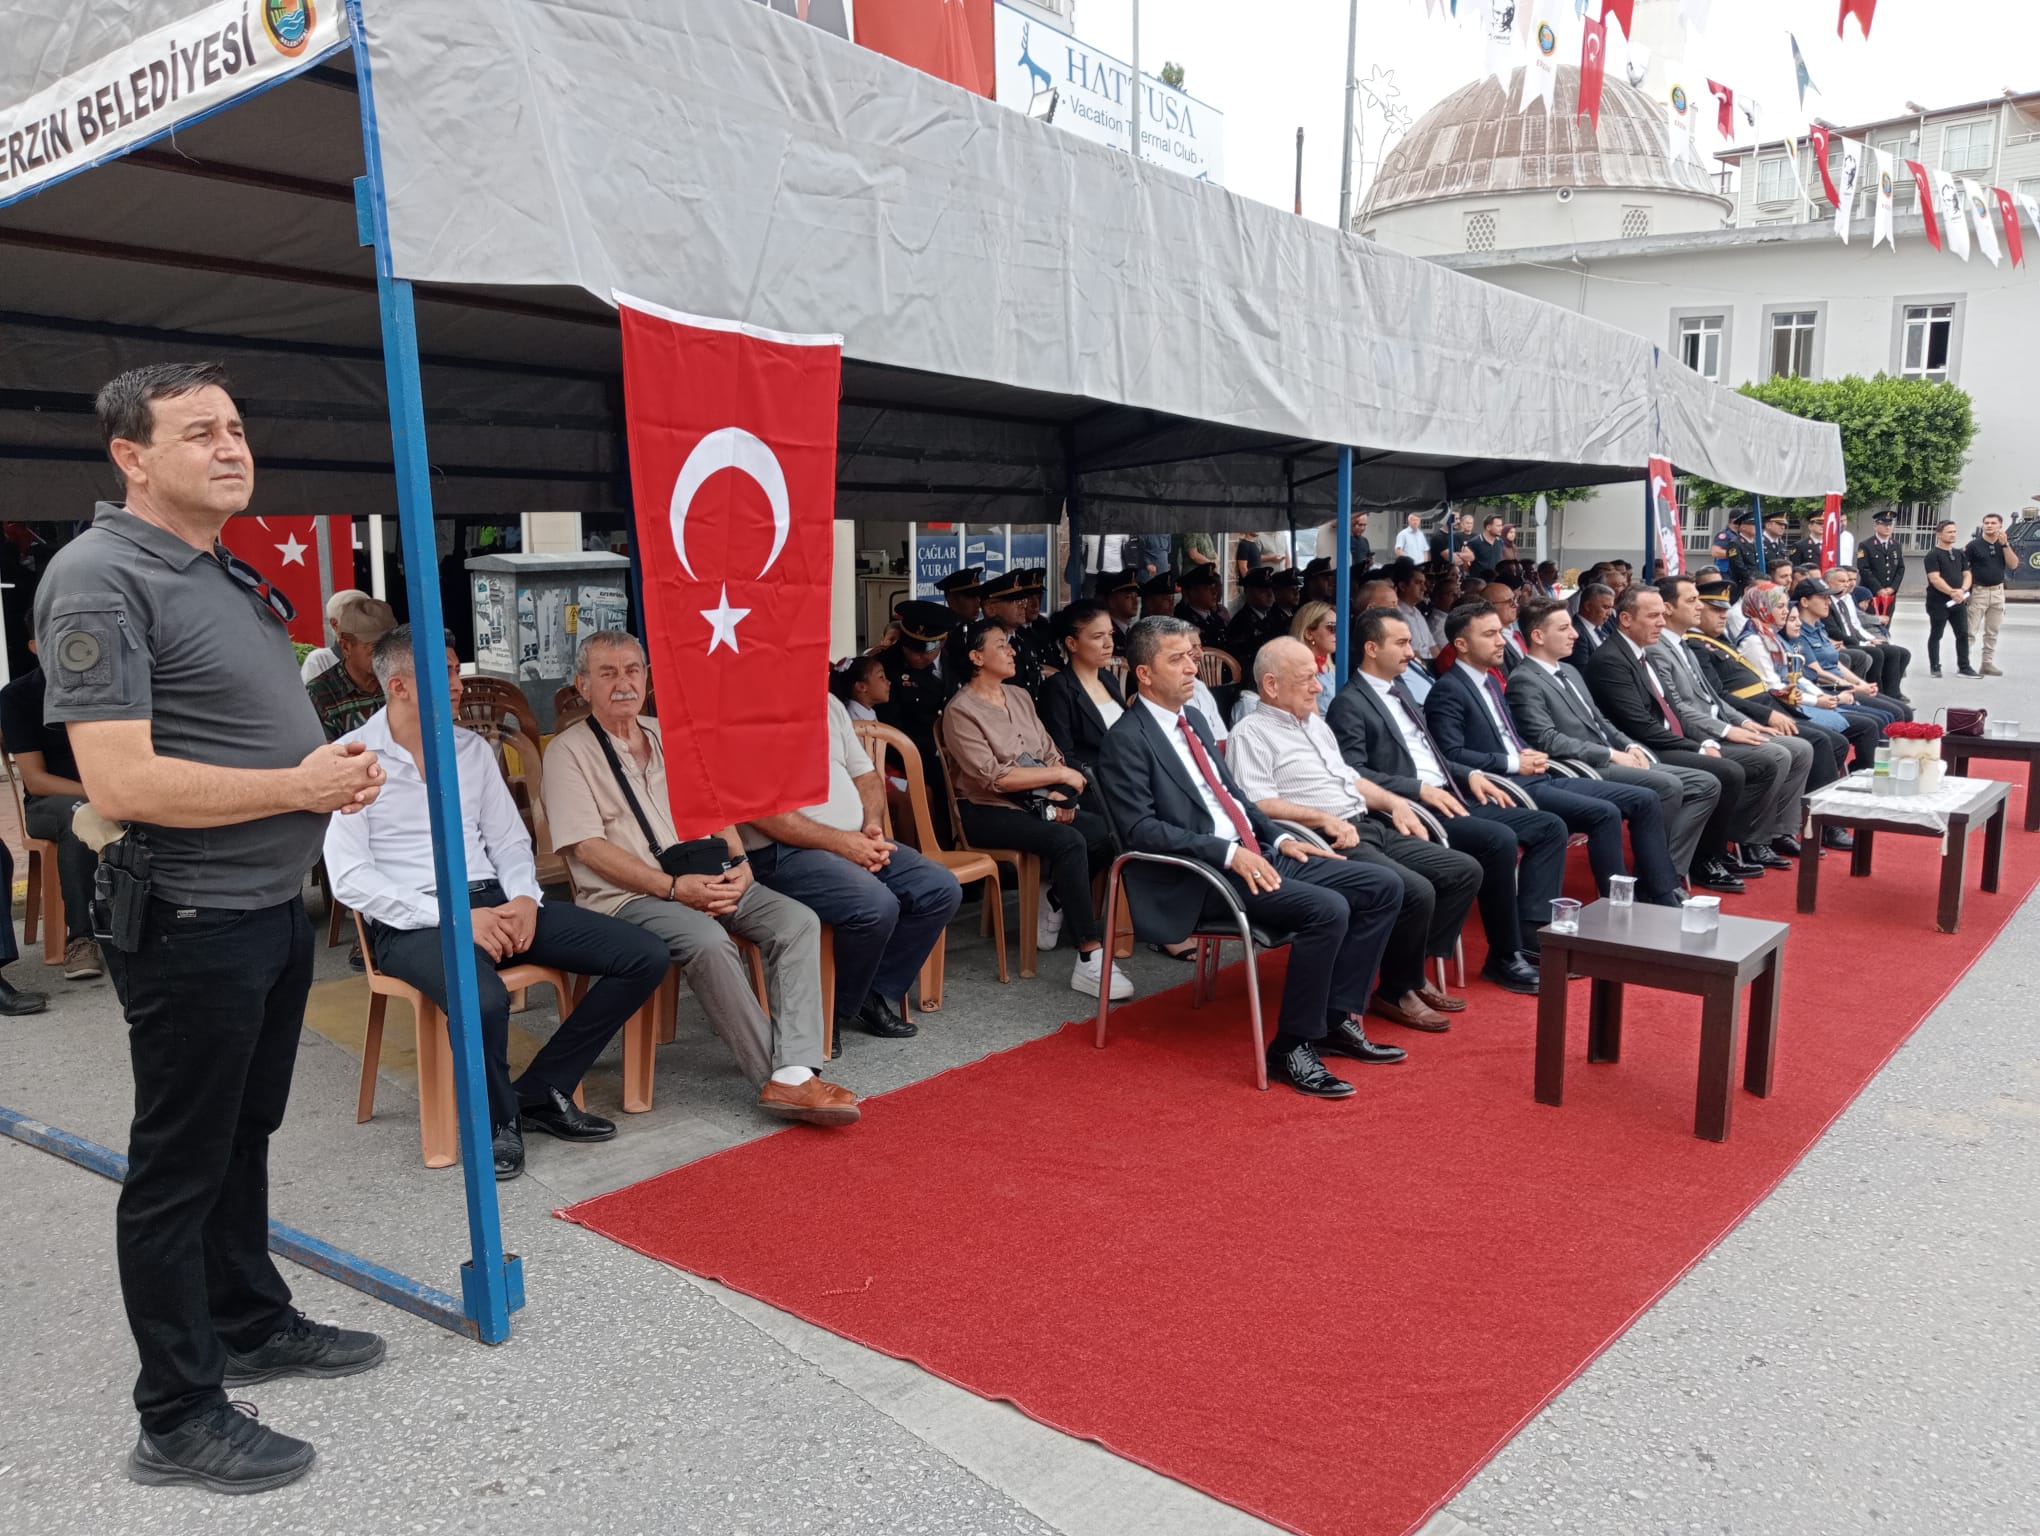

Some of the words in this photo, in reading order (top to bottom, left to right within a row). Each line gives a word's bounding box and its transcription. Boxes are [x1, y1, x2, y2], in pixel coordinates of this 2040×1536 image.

[77, 1, 256, 146] BELEDİYESİ
[1070, 95, 1123, 133] Vacation
[1125, 119, 1171, 153] Termal
[1173, 141, 1198, 165] Club
[918, 544, 957, 563] ÇAĞLAR
